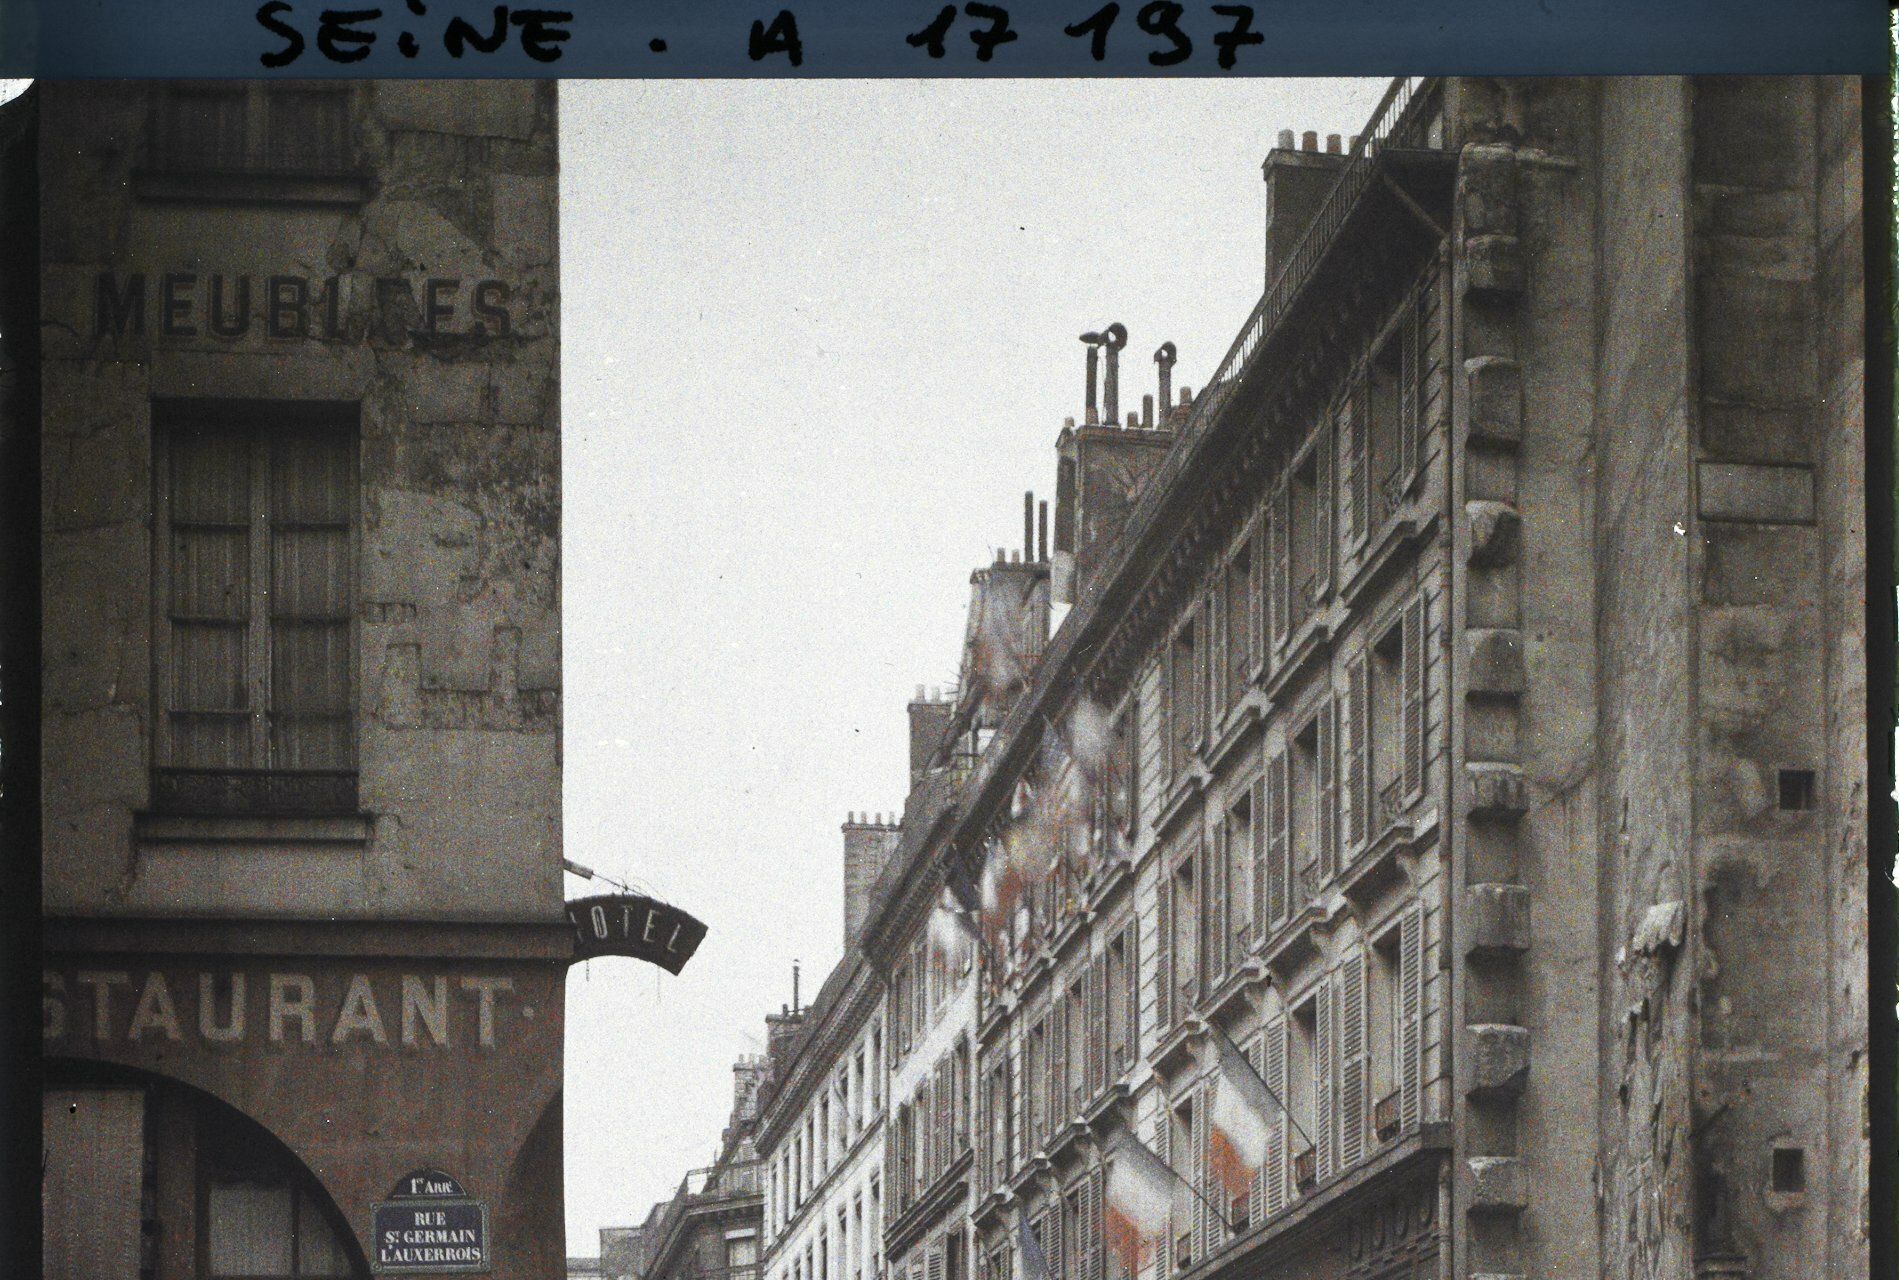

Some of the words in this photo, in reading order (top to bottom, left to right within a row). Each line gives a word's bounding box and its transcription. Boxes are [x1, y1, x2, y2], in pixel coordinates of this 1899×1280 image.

[906, 2, 1019, 63] 17
[1064, 2, 1265, 70] 197
[569, 904, 683, 954] OTEL
[415, 1211, 446, 1226] RUE
[403, 1229, 476, 1244] GERMAIN
[381, 1244, 481, 1262] L'AUXERROIS
